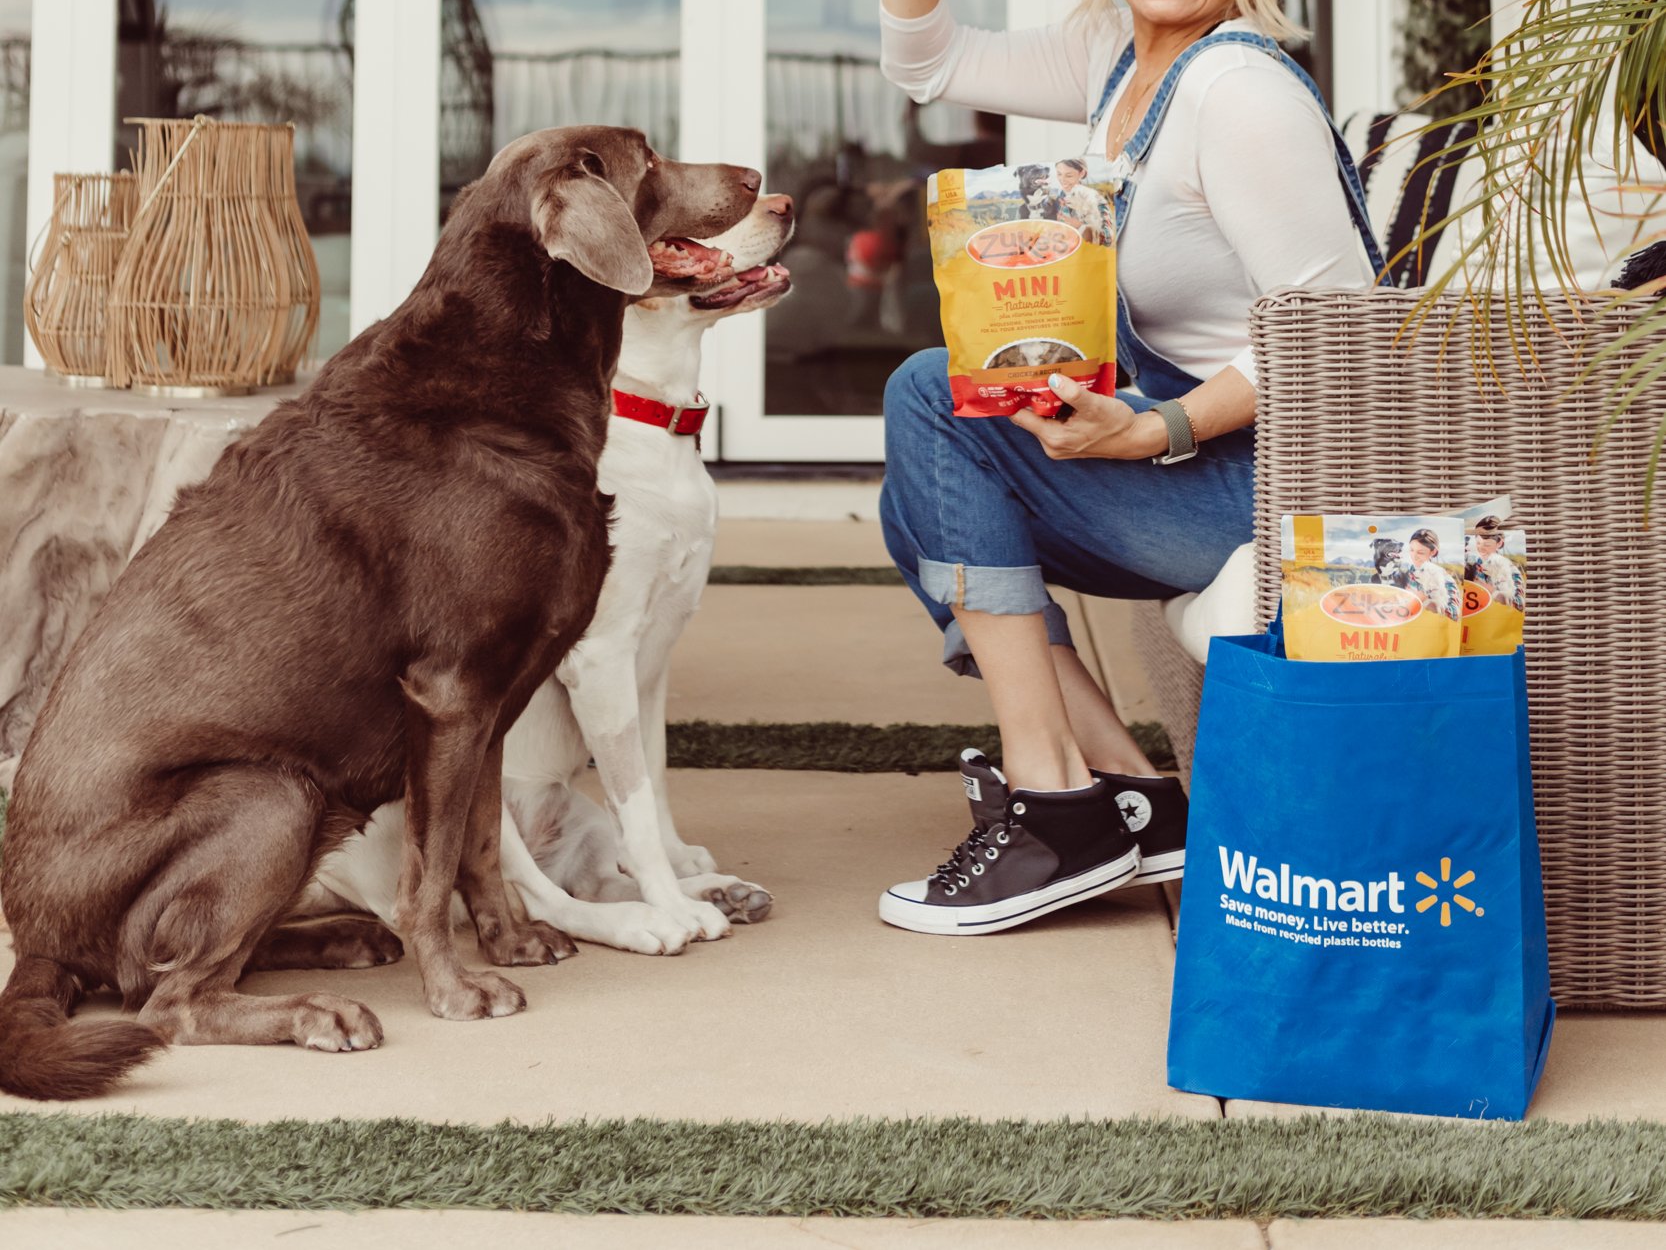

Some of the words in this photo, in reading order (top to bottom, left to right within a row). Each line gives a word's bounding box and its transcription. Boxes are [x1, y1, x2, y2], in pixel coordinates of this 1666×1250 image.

[992, 275, 1060, 301] MINI
[1340, 630, 1399, 652] MINI
[1218, 845, 1405, 913] Walmart
[1220, 894, 1253, 916] Save
[1255, 905, 1309, 930] money.
[1314, 916, 1348, 932] Live
[1352, 917, 1410, 935] better.
[1225, 913, 1253, 930] Made
[1253, 922, 1277, 936] from
[1279, 929, 1322, 946] recycled
[1324, 935, 1360, 948] plastic
[1362, 936, 1402, 949] bottles
